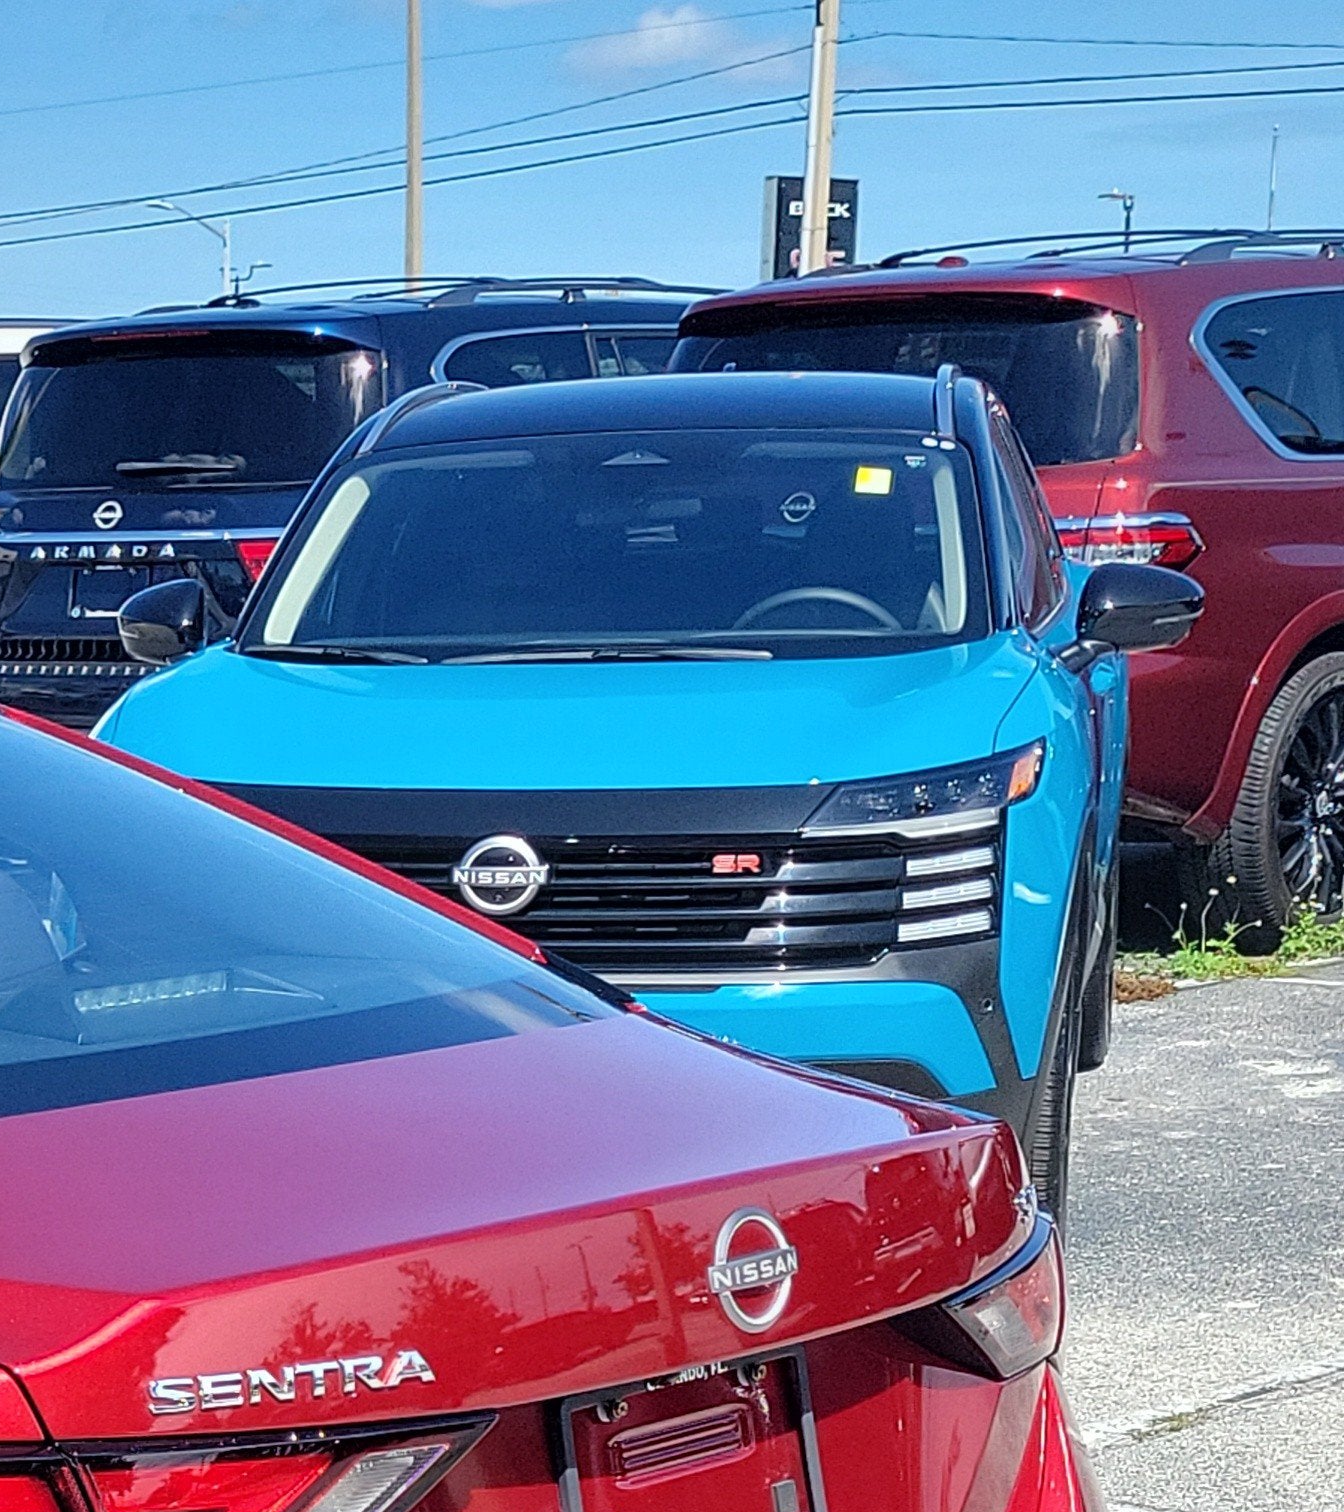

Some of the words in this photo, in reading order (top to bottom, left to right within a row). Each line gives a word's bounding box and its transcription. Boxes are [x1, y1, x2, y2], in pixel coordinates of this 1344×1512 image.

[788, 201, 851, 218] BCK
[29, 542, 176, 559] ARMADA
[712, 854, 762, 873] SR
[452, 869, 546, 885] NISSAN
[711, 1251, 798, 1290] NISSAN
[148, 1349, 437, 1415] SENTRA
